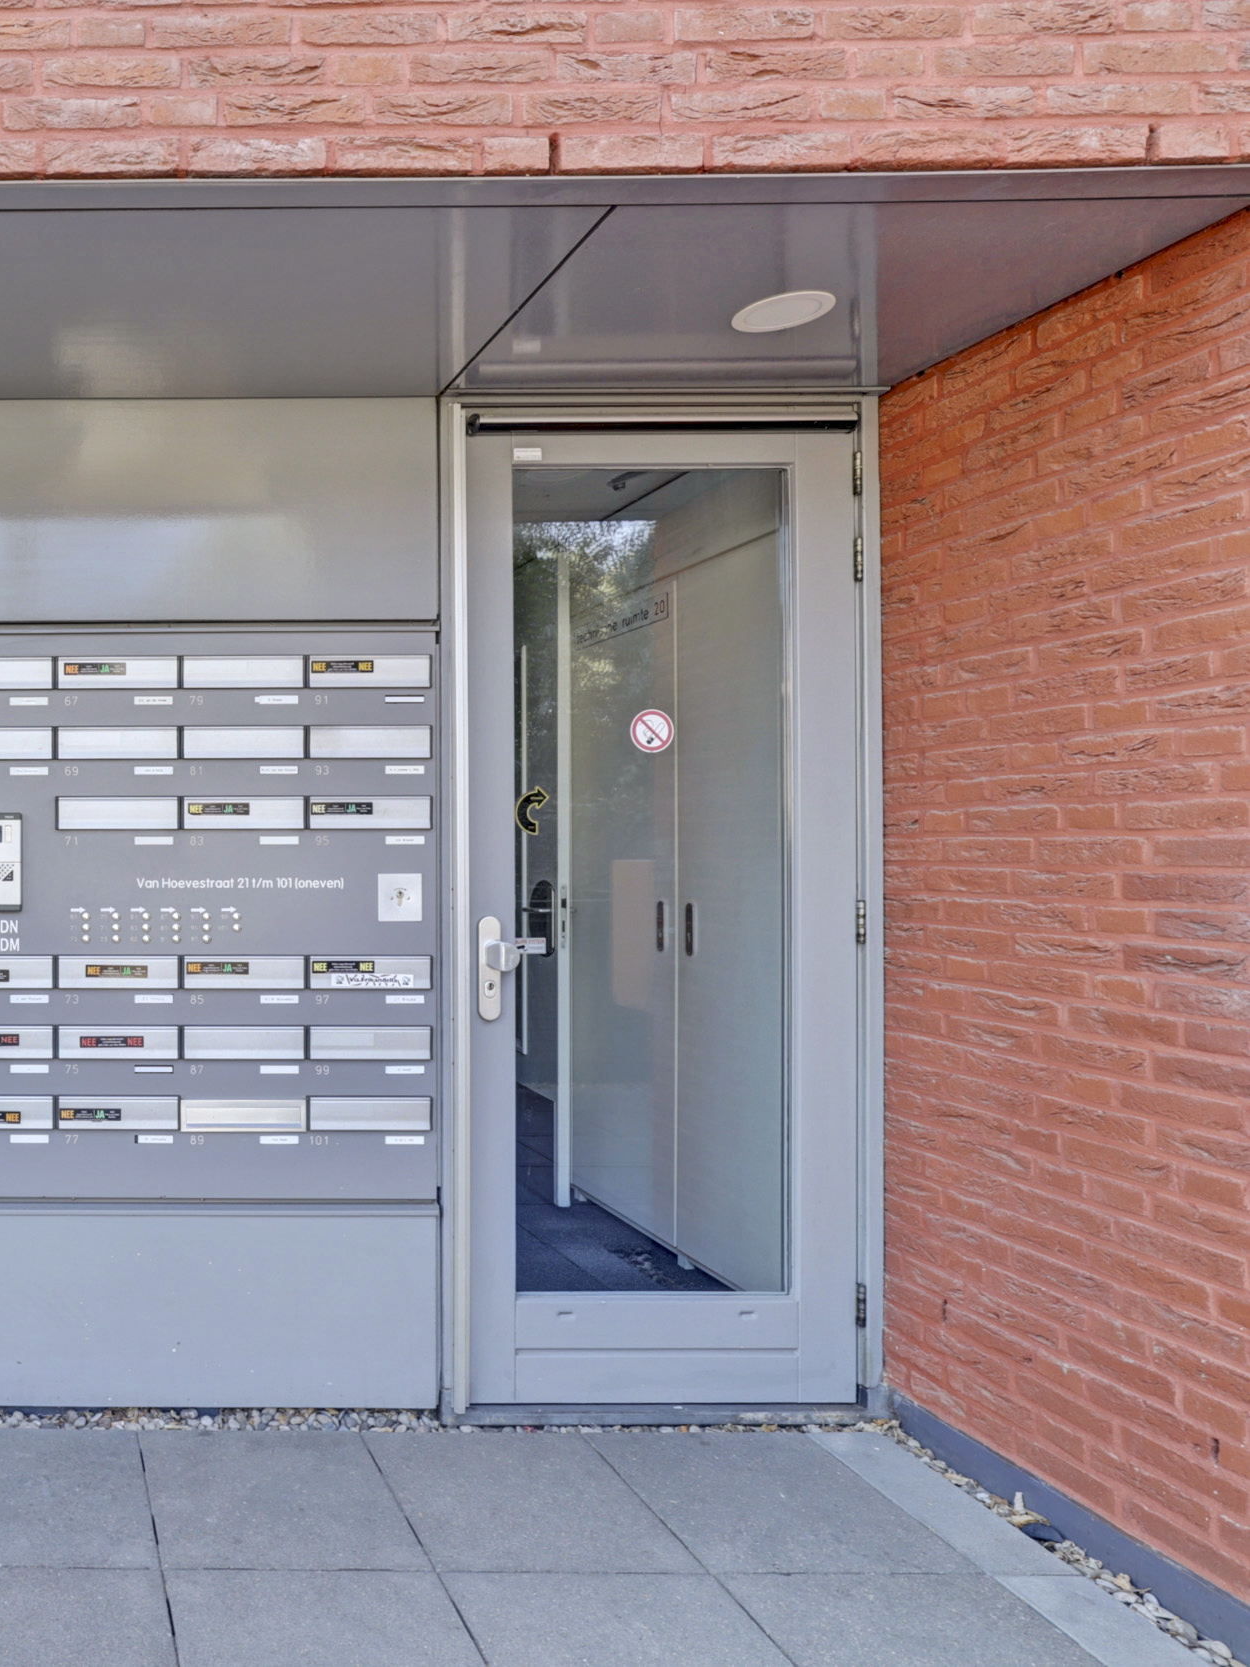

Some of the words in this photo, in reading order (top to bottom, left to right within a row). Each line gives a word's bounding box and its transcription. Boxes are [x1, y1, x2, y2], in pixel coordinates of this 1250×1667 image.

[621, 609, 649, 628] ruimte
[654, 599, 665, 616] 20
[65, 665, 79, 674] NEE
[99, 664, 110, 673] JA
[312, 662, 326, 671] NEE
[358, 662, 372, 671] NEE
[64, 695, 78, 706] 67
[189, 695, 204, 706] 79
[314, 694, 329, 705] 91
[64, 765, 79, 776] 69
[189, 765, 203, 776] 81
[314, 764, 329, 775] 93
[189, 804, 203, 814] NEE
[223, 804, 233, 814] JA
[312, 804, 326, 813] NEE
[346, 804, 357, 813] JA
[64, 836, 78, 846] 71
[189, 835, 204, 846] 83
[314, 835, 329, 846] 95
[136, 877, 159, 889] Van
[161, 877, 235, 889] Hoevestraat
[237, 877, 249, 889] 21
[250, 877, 274, 889] t/m
[276, 877, 292, 889] 101
[294, 877, 344, 890] (oneven)
[87, 966, 101, 975] NEE
[122, 966, 131, 976] JA
[187, 963, 202, 972] NEE
[222, 963, 233, 973] JA
[313, 962, 327, 972] NEE
[359, 962, 373, 971] NEE
[64, 994, 79, 1004] 73
[189, 994, 204, 1004] 85
[314, 994, 329, 1004] 97
[0, 1036, 18, 1044] NEE
[81, 1038, 97, 1046] NEE
[127, 1037, 143, 1046] NEE
[64, 1064, 79, 1075] 75
[189, 1064, 204, 1075] 87
[314, 1064, 330, 1075] 99
[5, 1113, 20, 1122] NEE
[61, 1110, 75, 1119] NEE
[95, 1110, 105, 1119] JA
[64, 1134, 79, 1145] 77
[189, 1134, 204, 1145] 89
[309, 1135, 329, 1145] 101
